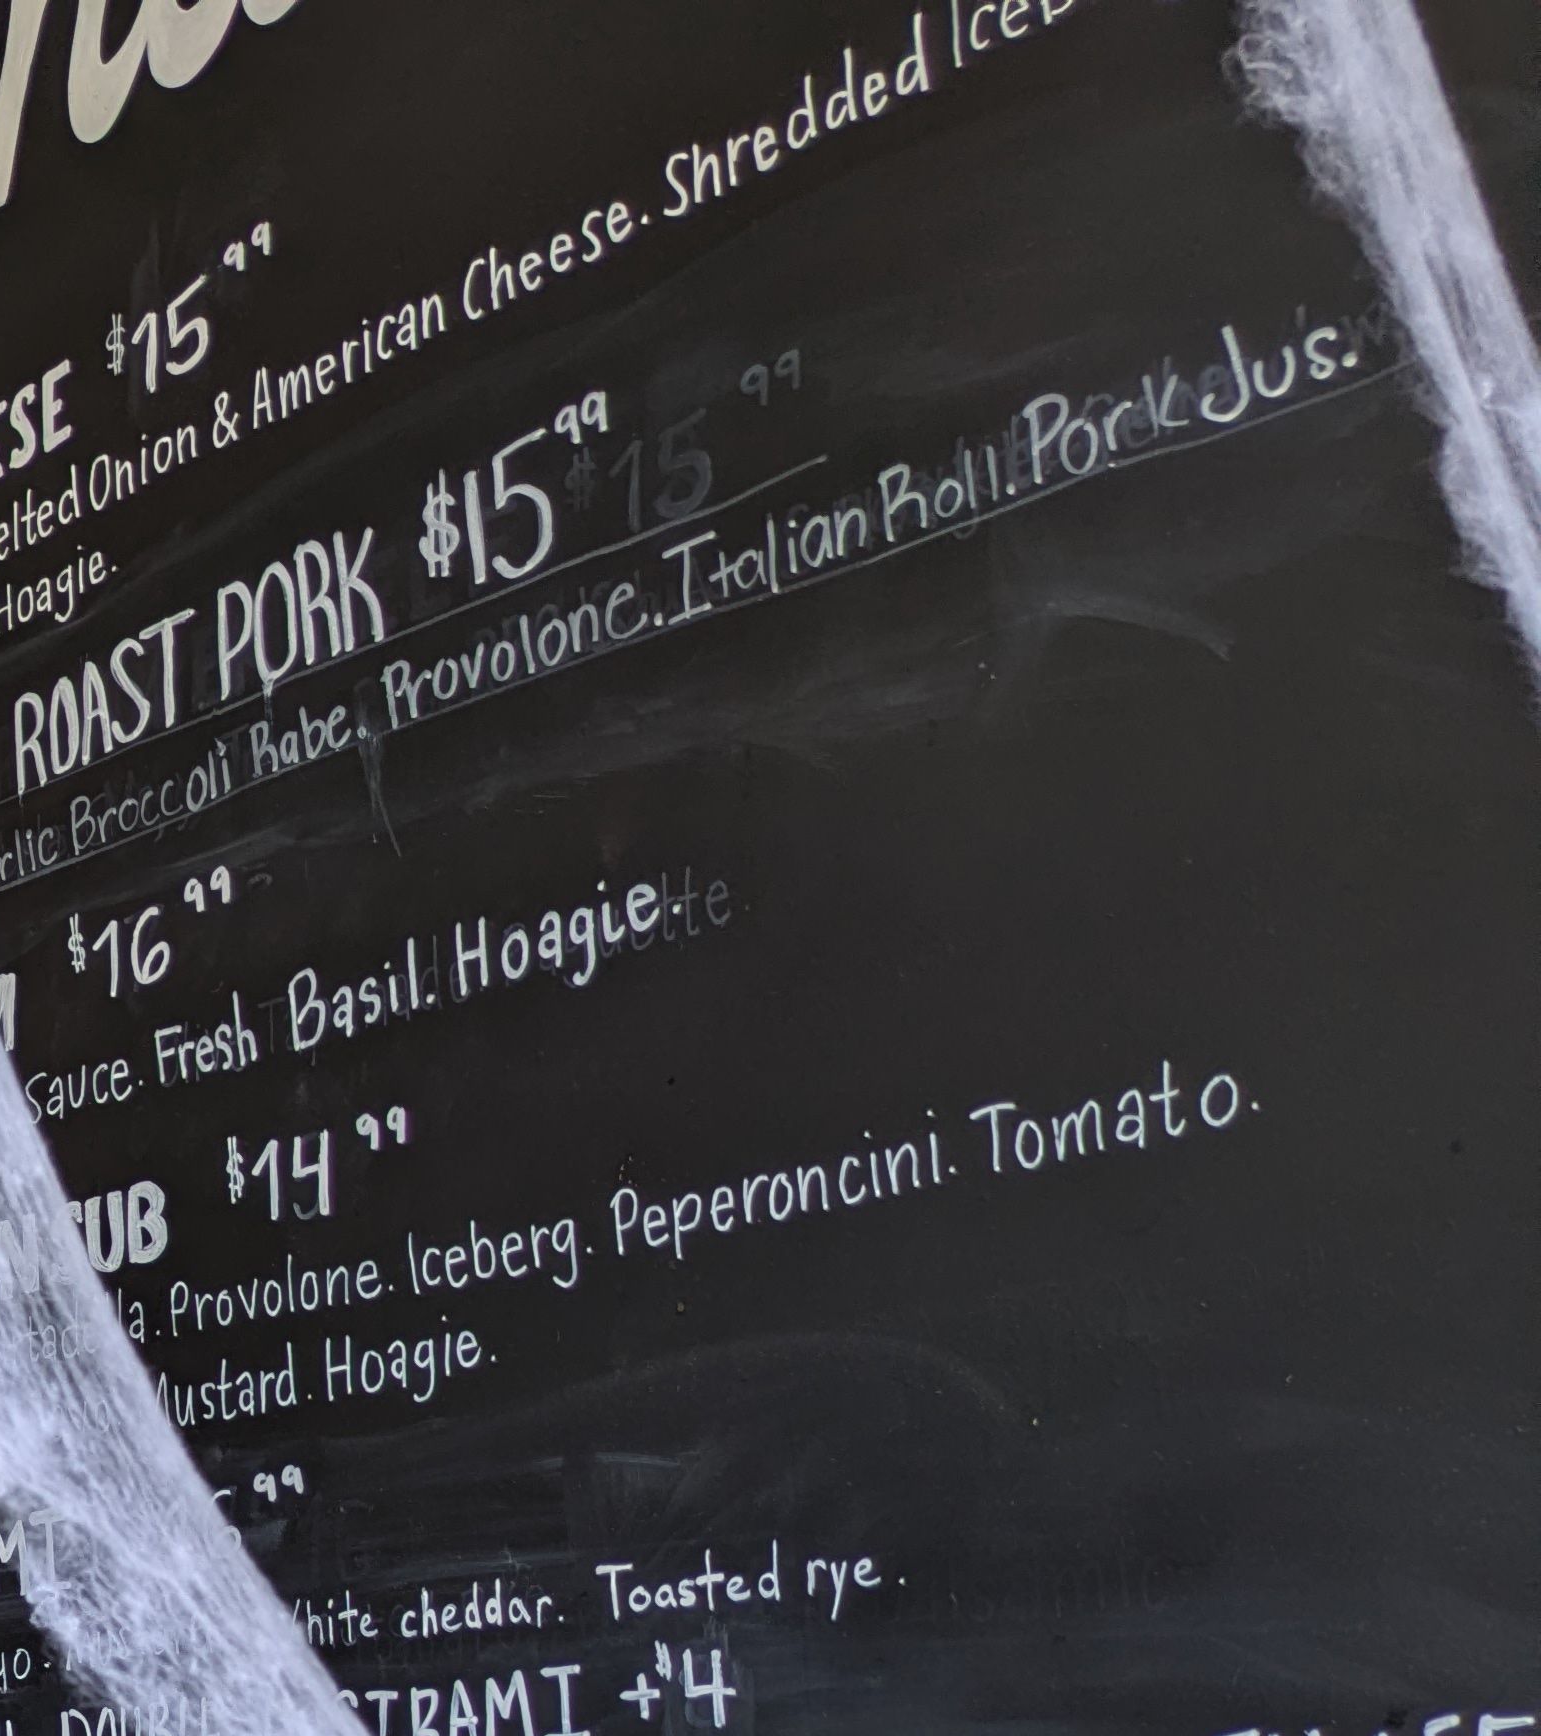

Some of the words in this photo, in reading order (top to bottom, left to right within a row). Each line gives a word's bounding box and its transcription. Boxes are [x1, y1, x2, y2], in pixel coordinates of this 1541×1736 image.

[88, 425, 196, 511] Onion
[213, 391, 240, 442] &
[252, 292, 447, 430] American
[462, 200, 650, 321] Cheese.
[662, 12, 929, 218] Shredded
[17, 608, 194, 797] ROAST
[218, 528, 385, 702] PORK
[71, 743, 229, 852] Broccoli
[381, 581, 663, 731] Provolone.
[878, 445, 1015, 543] Roll.
[1025, 392, 1187, 485] Pork
[1200, 325, 1357, 422] Jus.
[154, 992, 259, 1080] Fresh
[289, 937, 435, 1051] Basil.
[455, 880, 681, 998] Hoagie.
[170, 1256, 394, 1336] Provolone.
[408, 1220, 592, 1290] Iceberg.
[610, 1107, 957, 1260] Peperoncini.
[970, 1060, 1261, 1174] Tomato.
[325, 1313, 498, 1404] Hoagie.
[400, 1578, 565, 1641] cheddar.
[596, 1540, 781, 1620] Toasted
